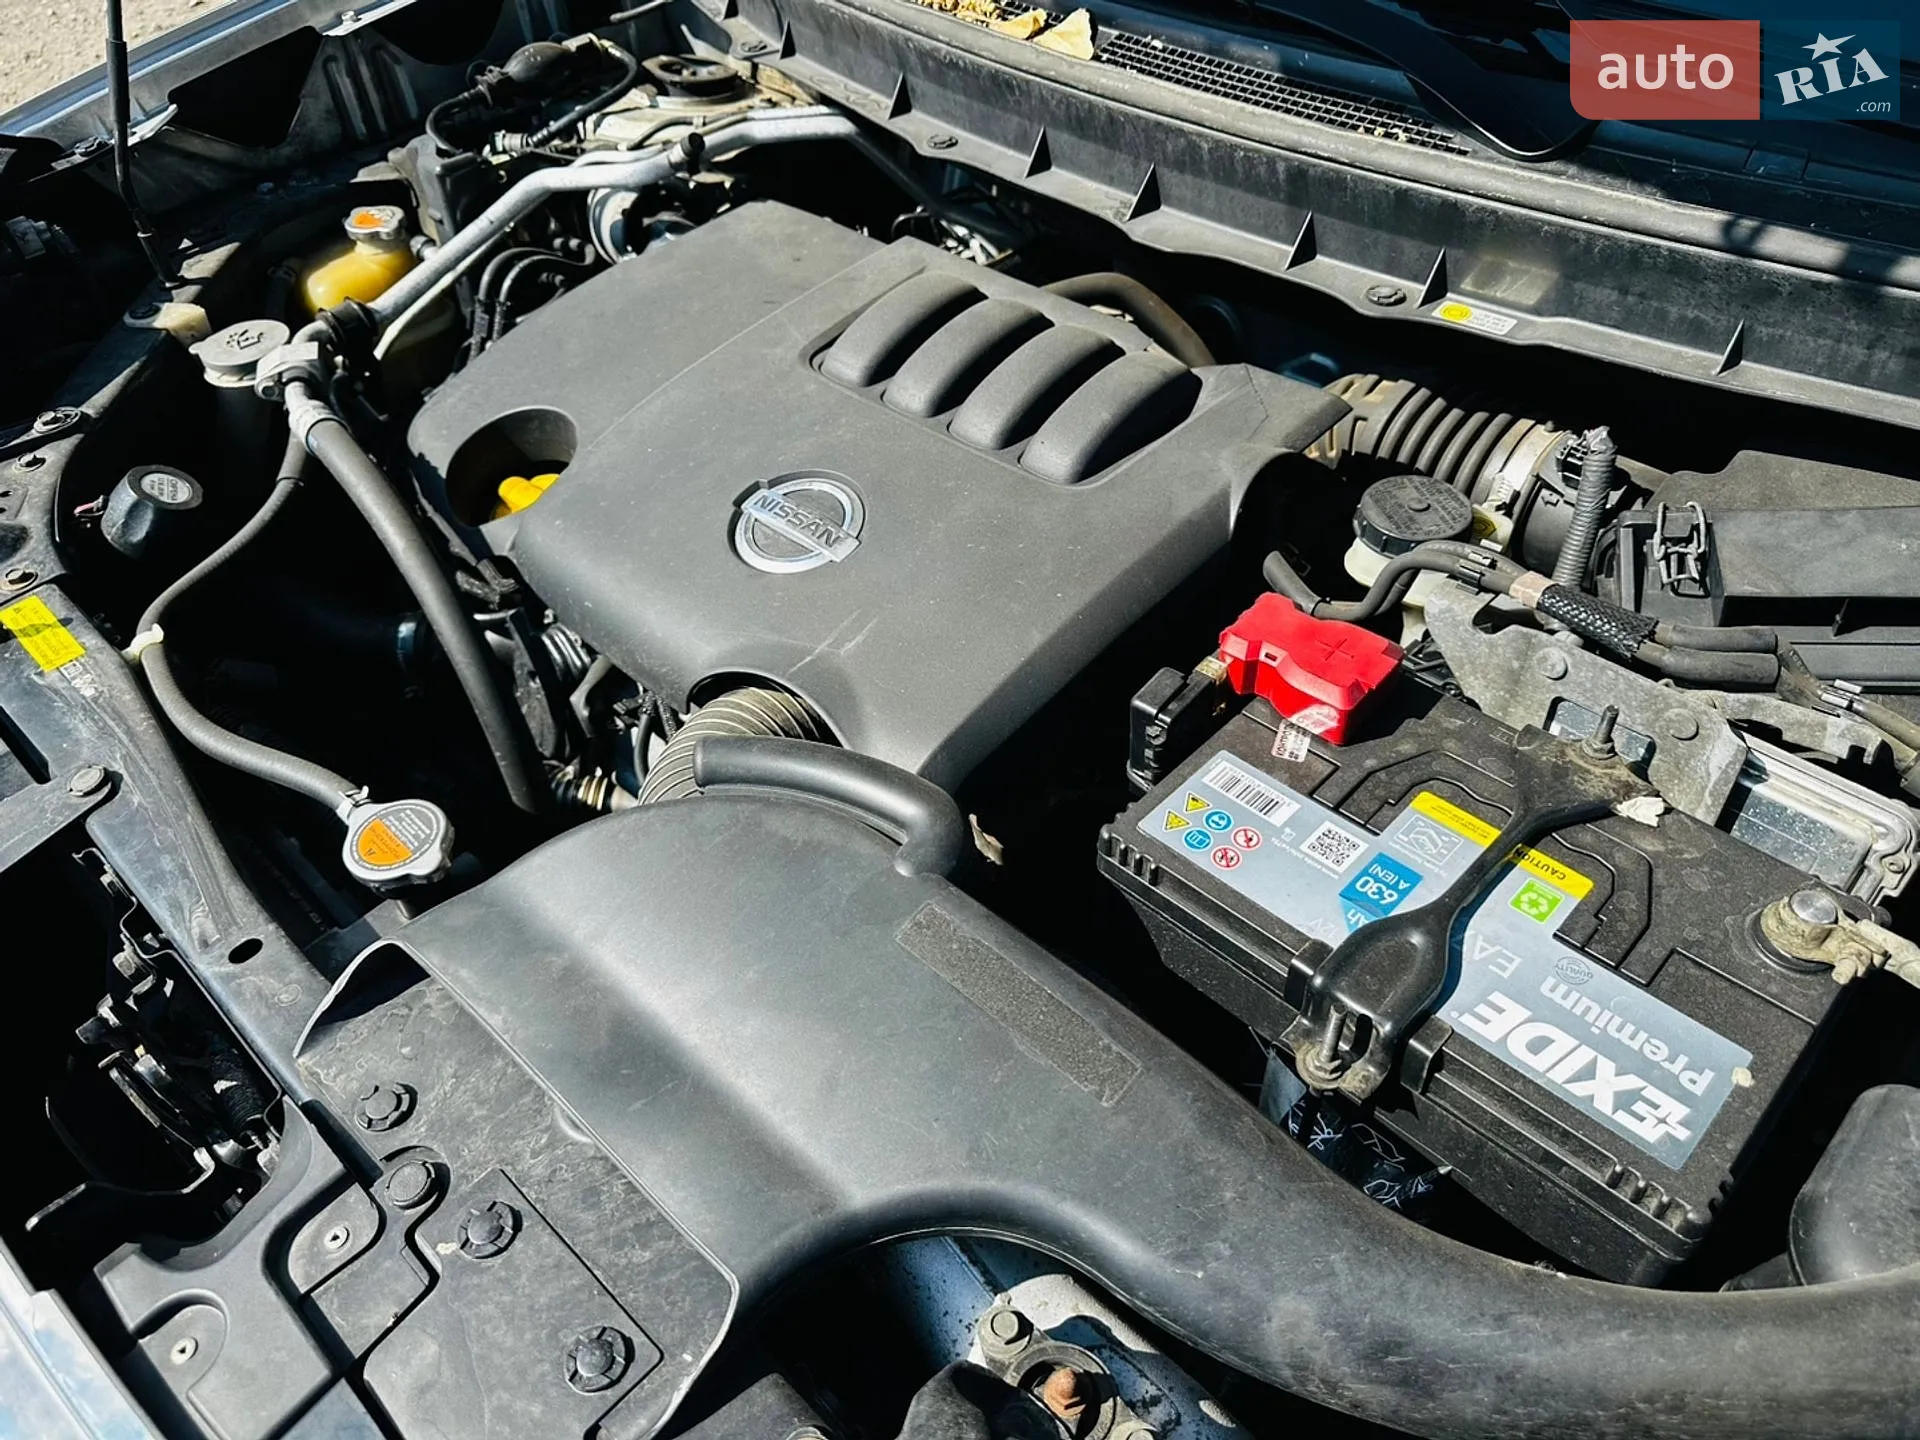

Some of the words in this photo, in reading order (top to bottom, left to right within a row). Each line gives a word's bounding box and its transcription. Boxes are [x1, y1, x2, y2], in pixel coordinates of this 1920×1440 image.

[753, 494, 845, 548] NISSAN
[1356, 876, 1398, 905] 630
[1513, 848, 1567, 881] CAUTION
[1539, 975, 1715, 1097] Premium
[1453, 990, 1693, 1144] EXIDE
